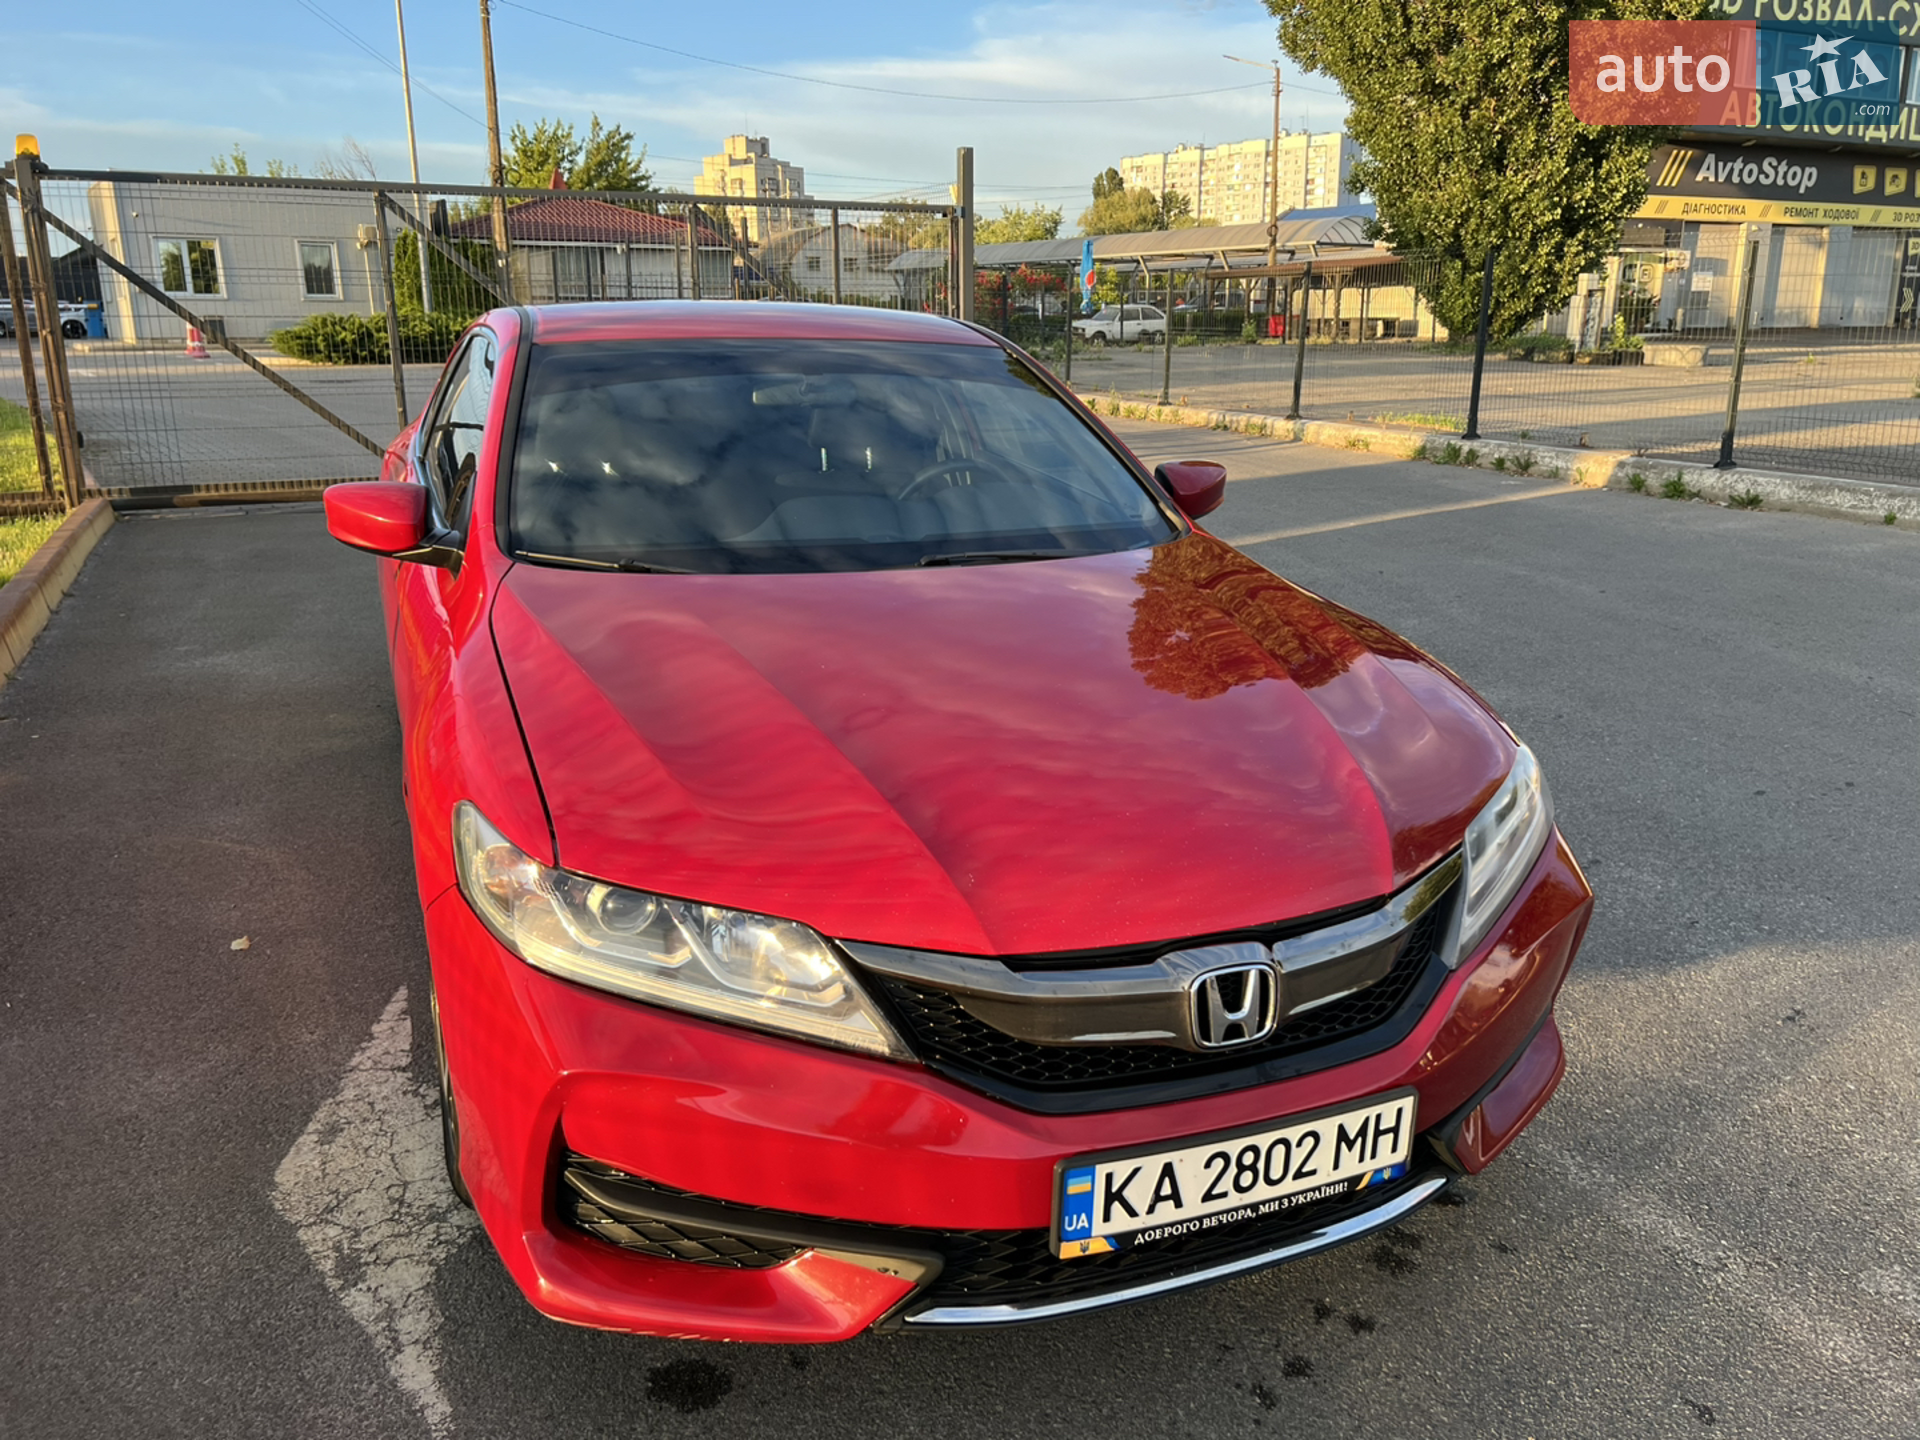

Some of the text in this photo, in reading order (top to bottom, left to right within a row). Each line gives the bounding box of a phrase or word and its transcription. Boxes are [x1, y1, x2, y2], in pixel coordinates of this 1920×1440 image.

[1695, 153, 1818, 194] AvtoStop
[1681, 202, 1746, 216] ДІАГНОСТИКА
[1783, 206, 1860, 221] РЕМОНТ ХОДОВОЇ
[1904, 212, 1920, 223] РОЗ
[1102, 1106, 1403, 1223] KA 2802 MH
[1202, 1207, 1257, 1229] ВЕЧОРА,
[1258, 1200, 1280, 1215] МИ
[1290, 1182, 1348, 1206] УКРАЇНИ!
[1064, 1213, 1089, 1231] UA
